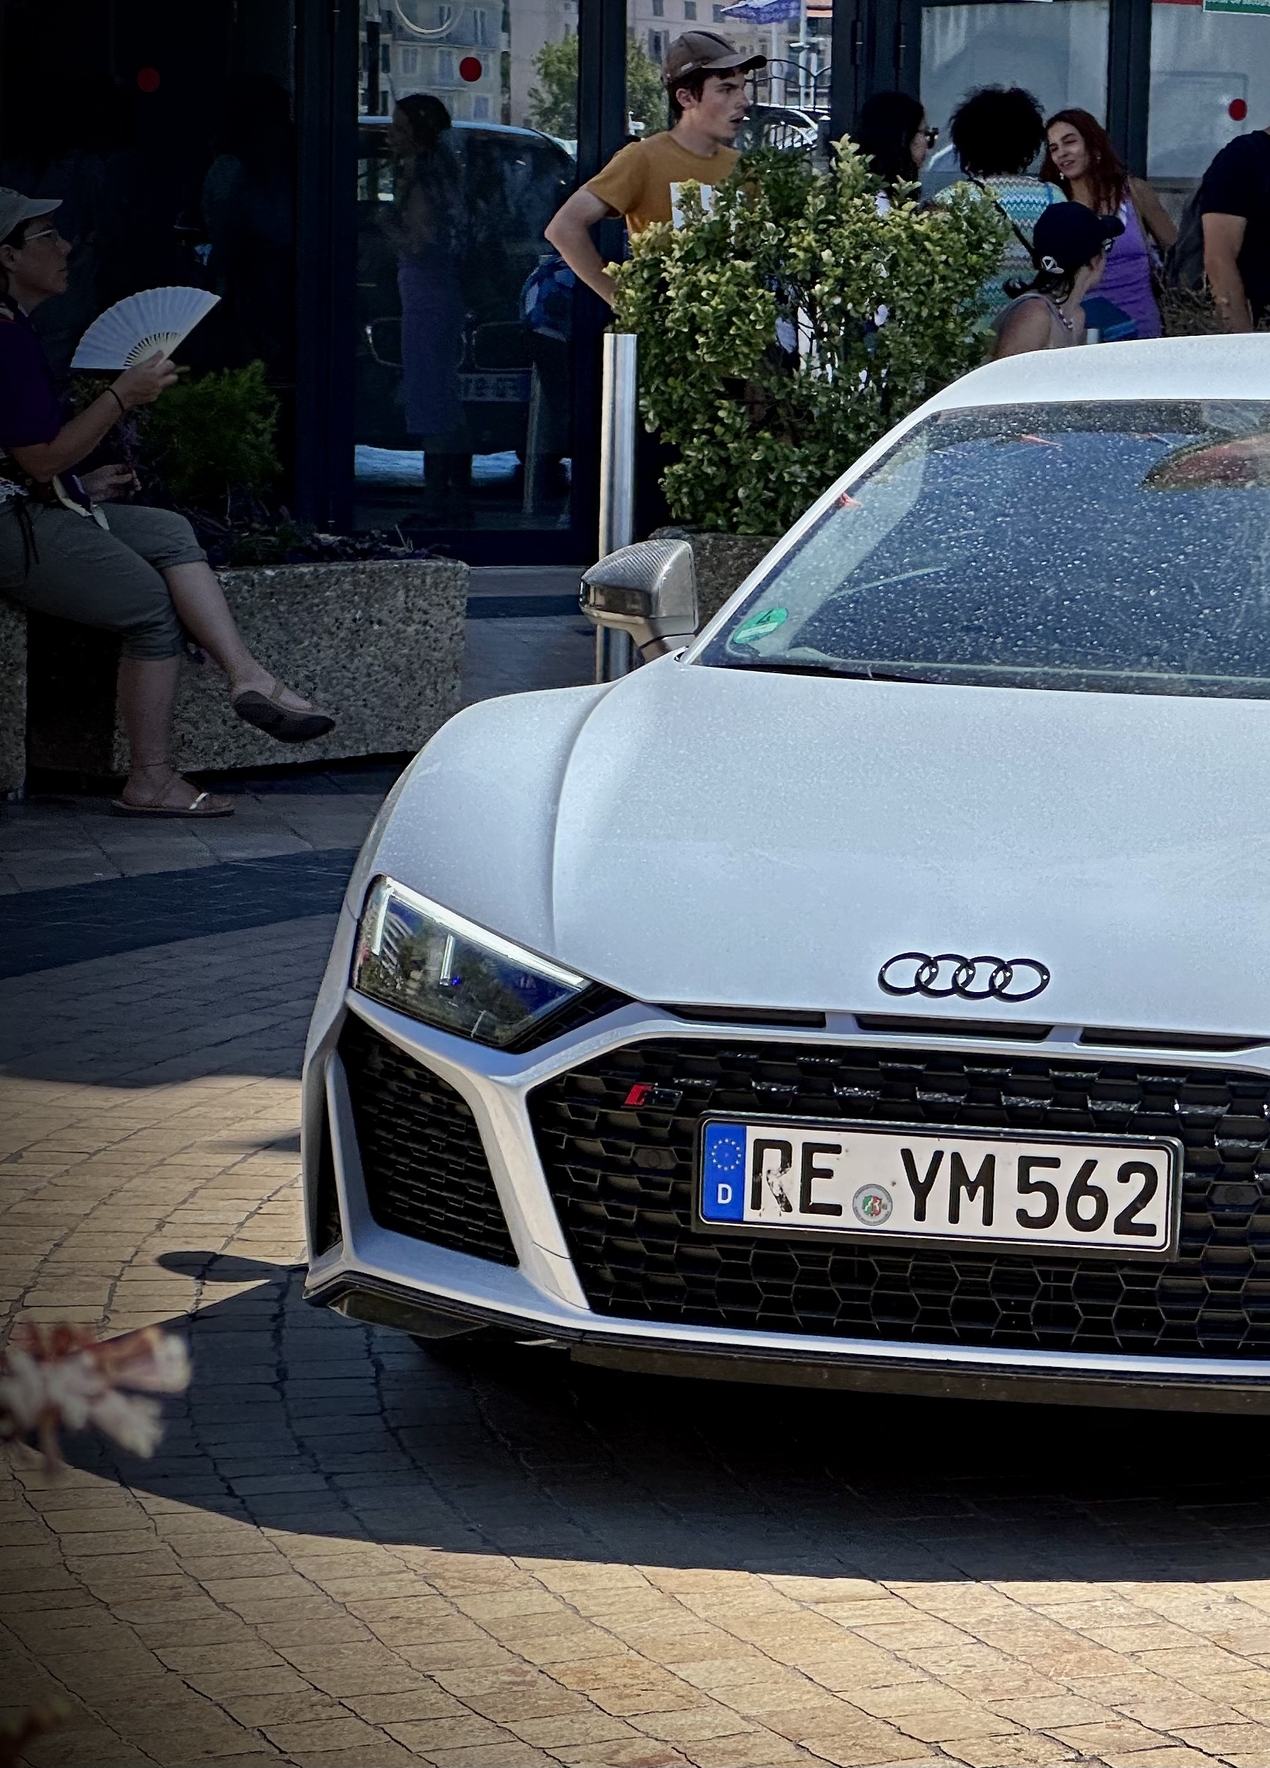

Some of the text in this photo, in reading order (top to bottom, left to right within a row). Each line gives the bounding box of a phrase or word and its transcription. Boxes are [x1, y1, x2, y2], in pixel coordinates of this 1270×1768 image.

[717, 1184, 731, 1204] D
[751, 1139, 1158, 1237] RE YM 562
